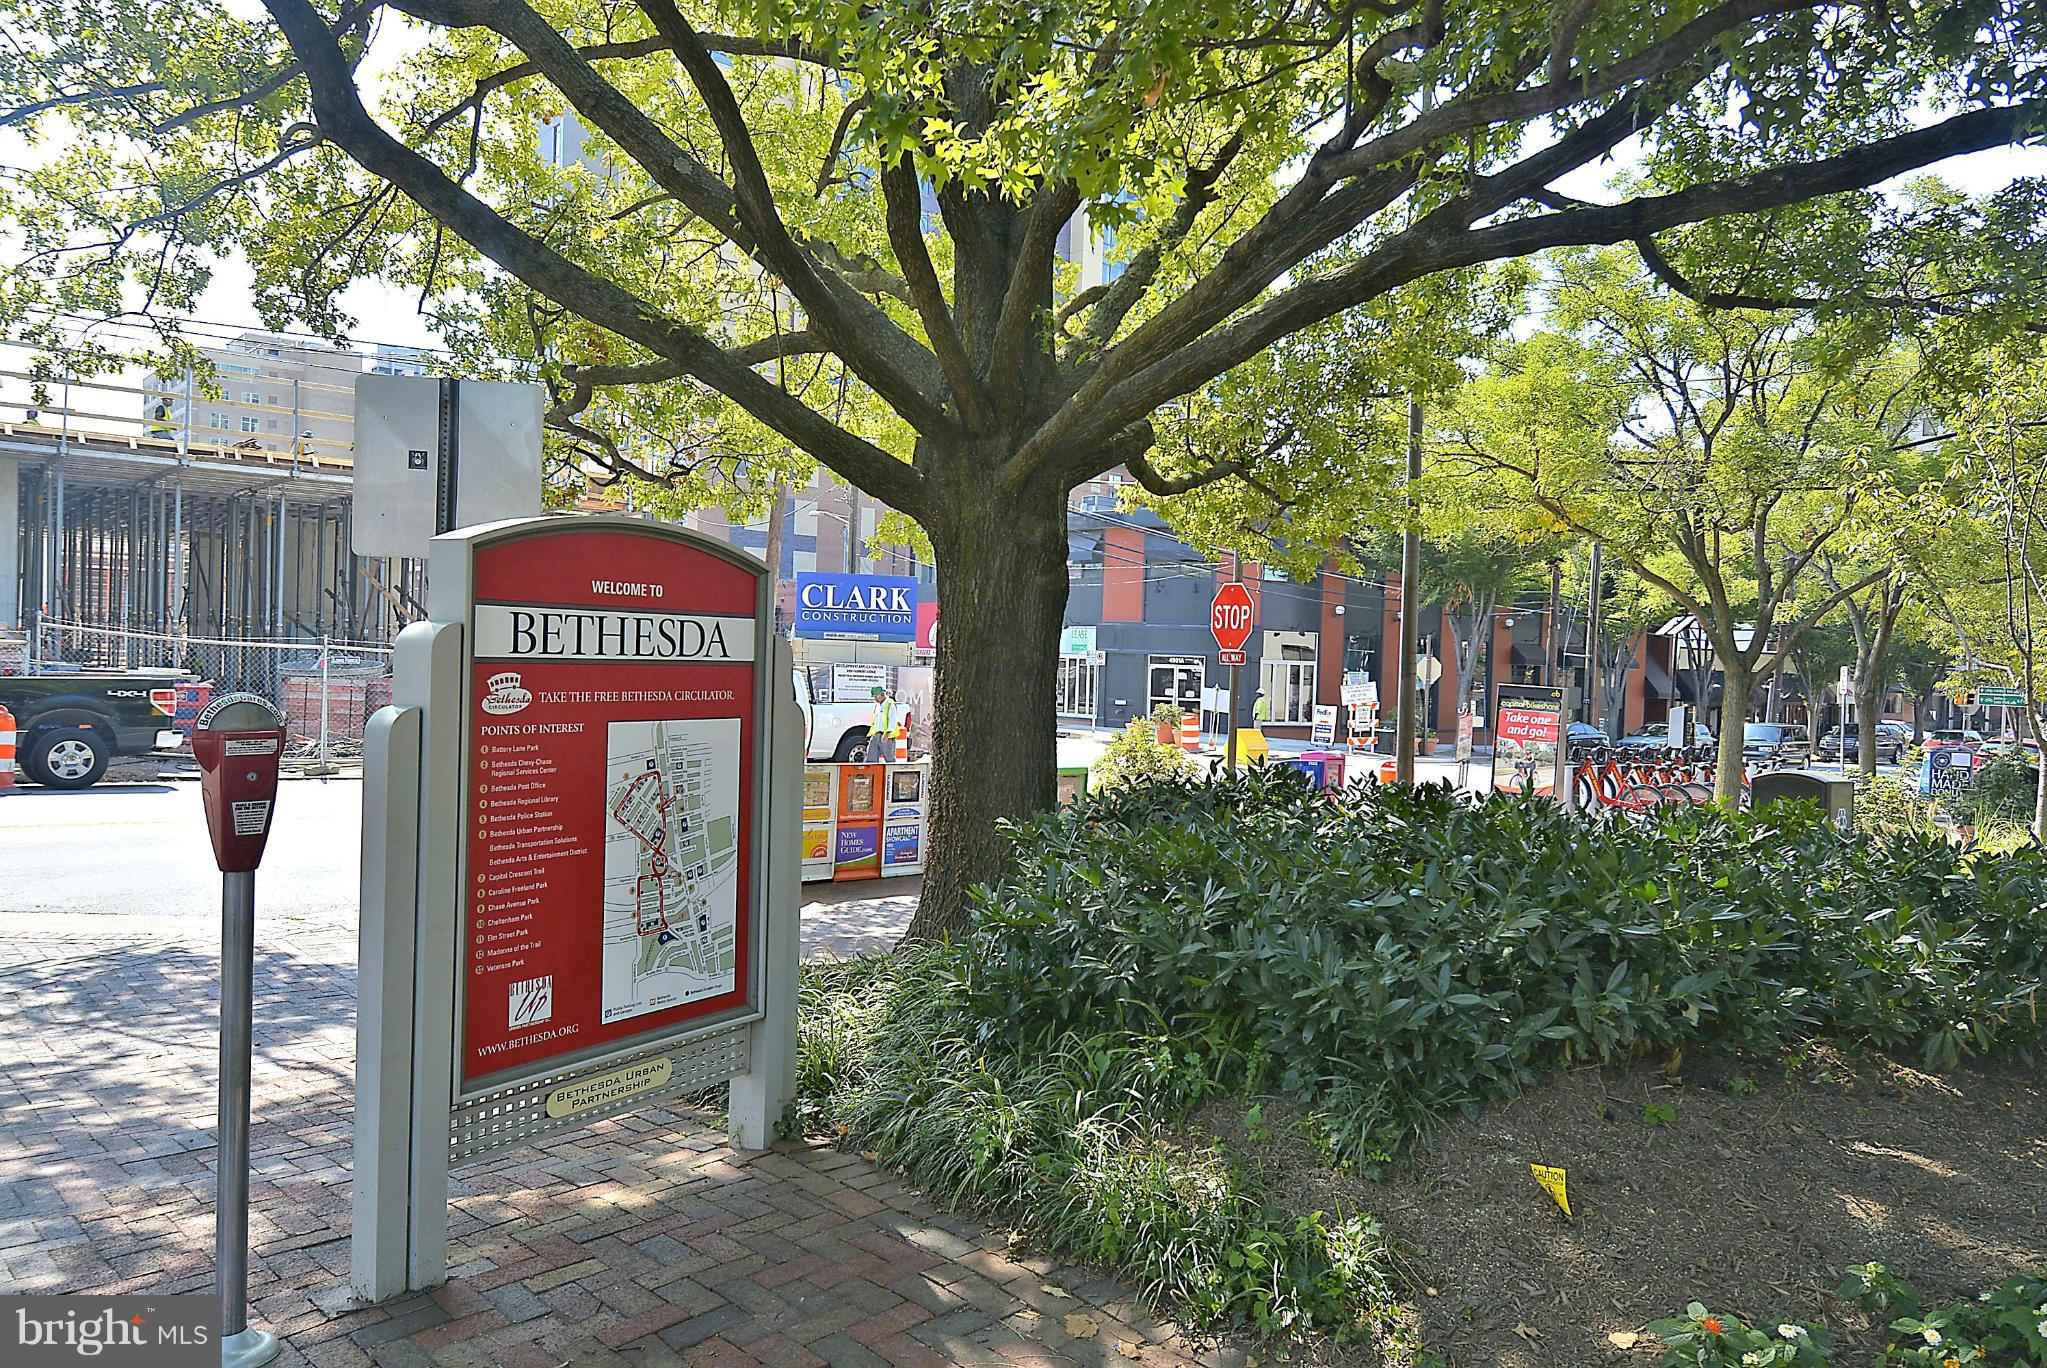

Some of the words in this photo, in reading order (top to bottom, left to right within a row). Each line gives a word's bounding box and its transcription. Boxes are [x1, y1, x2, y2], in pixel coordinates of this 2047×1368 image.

[592, 580, 647, 596] WELCOME
[649, 585, 663, 597] TO
[802, 584, 911, 611] CLARK
[802, 611, 912, 624] CONSTRUCTION
[1214, 605, 1250, 630] STOP
[508, 612, 730, 658] BETHESDA
[1072, 630, 1088, 639] LEASE
[486, 692, 530, 704] Bethesda
[539, 691, 567, 703] TAKE
[569, 691, 591, 703] THE
[594, 691, 619, 702] FREE
[621, 691, 672, 701] BETHESDA
[675, 690, 734, 701] CIRCULATOR.
[199, 694, 283, 726] BethesdaCares.com
[1506, 712, 1529, 722] Take
[1531, 716, 1551, 724] one
[481, 726, 520, 735] POINTS
[523, 725, 536, 734] OF
[540, 723, 584, 733] INTEREST
[1507, 725, 1528, 735] and
[1530, 727, 1547, 738] go!
[491, 769, 515, 777] Regional
[1932, 779, 1970, 789] MADE
[518, 797, 540, 805] Regional
[534, 824, 563, 833] Partnership
[886, 826, 918, 836] APARTMENT
[490, 844, 515, 852] Bethesda
[517, 840, 553, 848] Transportation
[555, 836, 577, 844] Solutions
[841, 846, 872, 854] GUIDE.com
[490, 858, 515, 866] Bethesda
[534, 850, 569, 860] Entertainment
[570, 848, 588, 856] District
[509, 869, 532, 878] Crescent
[489, 888, 511, 896] Caroline
[512, 884, 535, 893] Freeland
[506, 901, 526, 909] Avenue
[488, 916, 519, 926] Cheltenham
[488, 934, 497, 942] Elm
[499, 932, 515, 940] Street
[487, 948, 513, 957] Madonna
[487, 963, 511, 972] Veterans
[478, 1024, 579, 1057] WWW.BETHESDA.ORG
[557, 1077, 620, 1102] BETHESDA
[626, 1064, 664, 1080] URBAN
[572, 1078, 651, 1109] PARTNERSHIP
[1534, 1168, 1564, 1182] CAUTION
